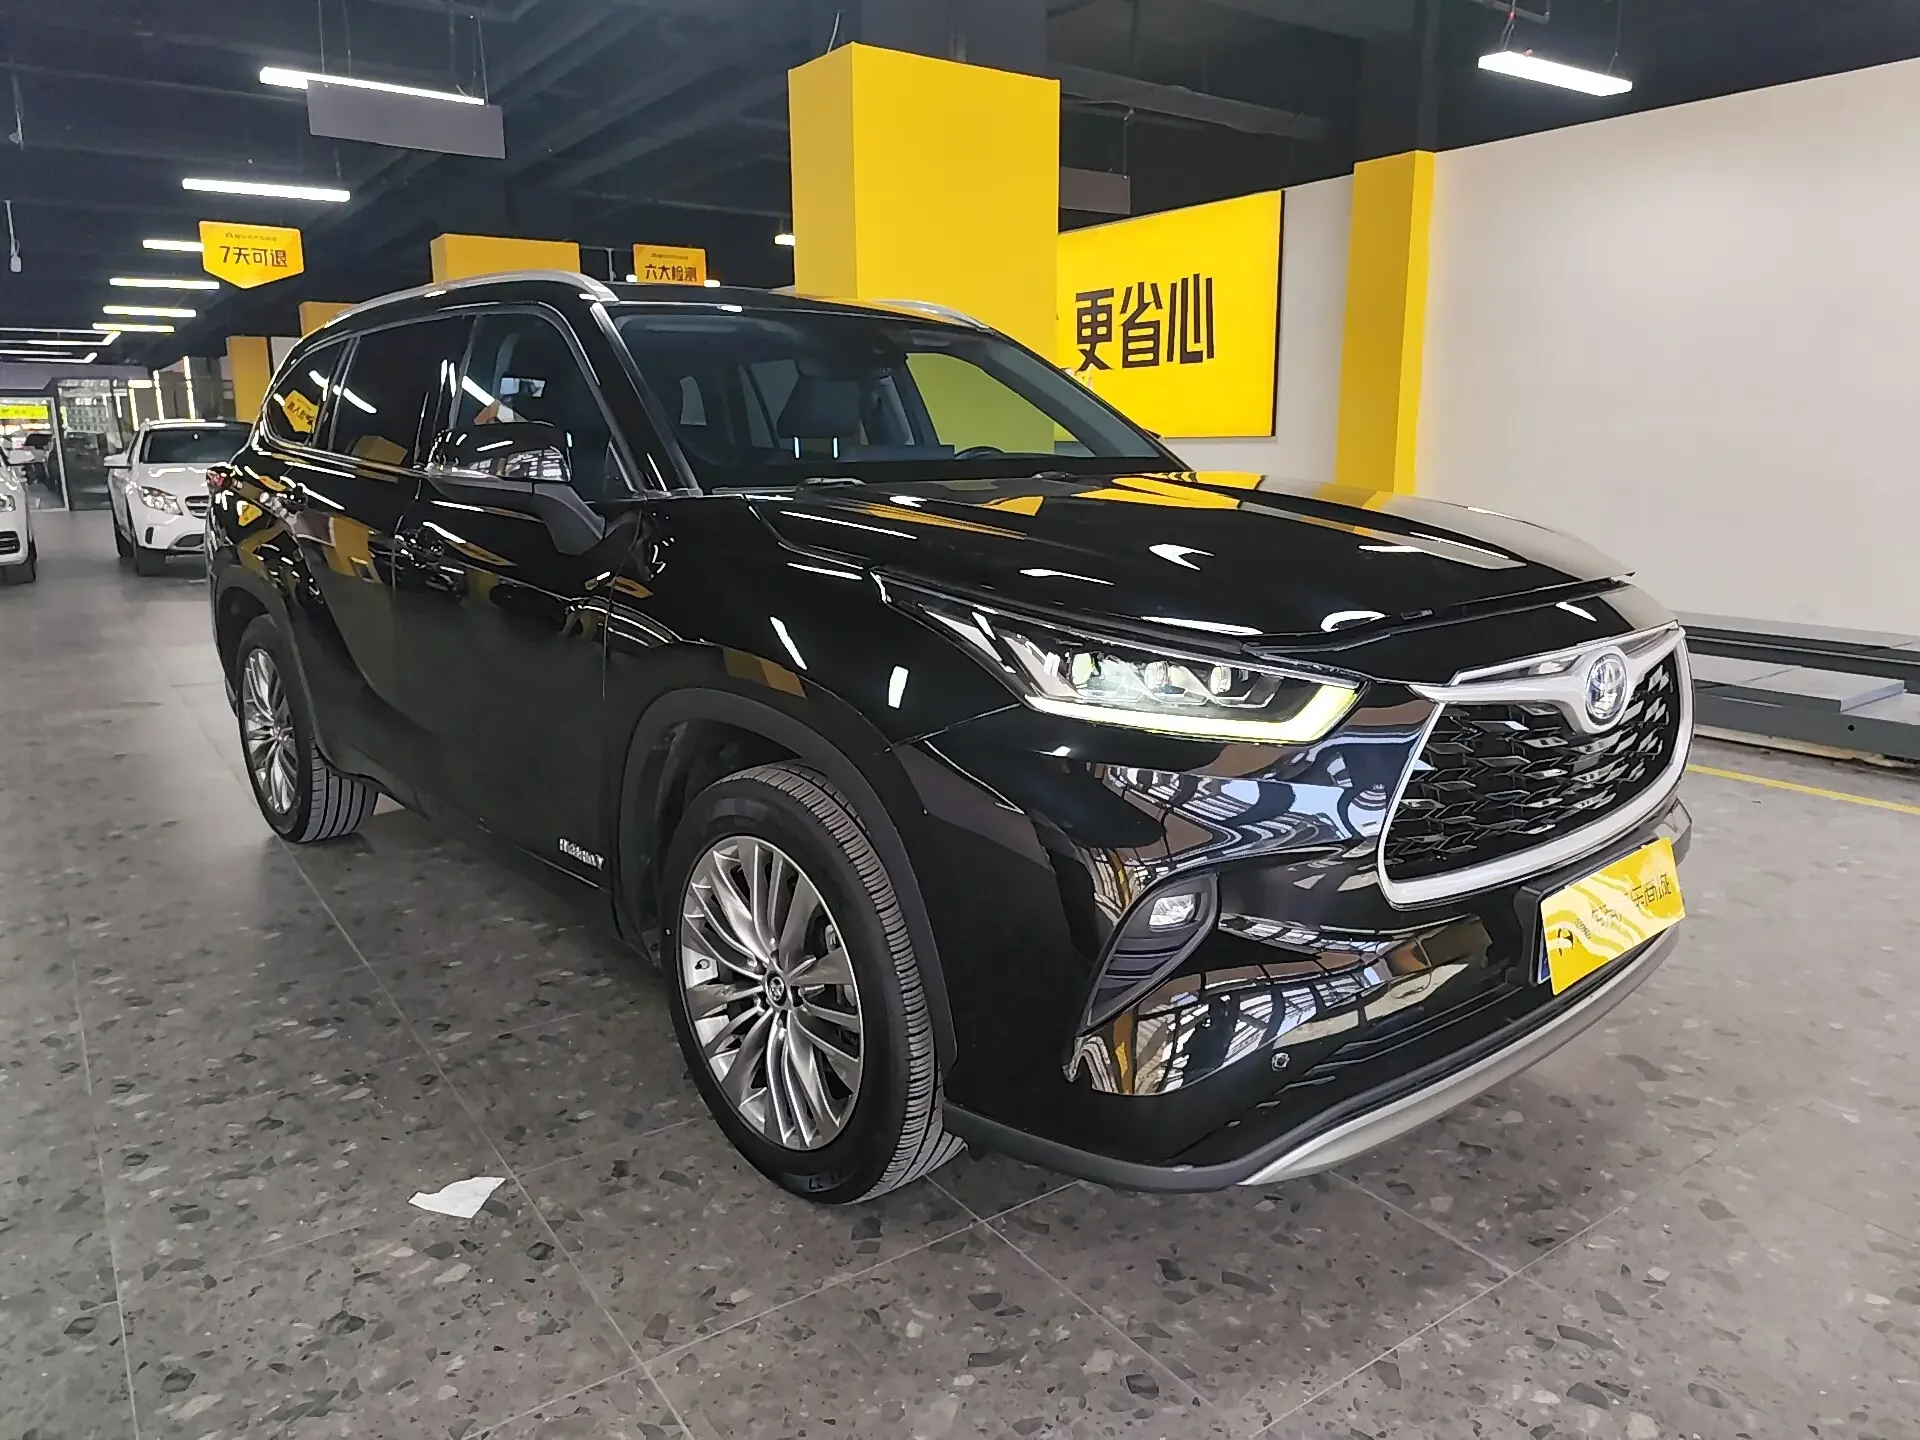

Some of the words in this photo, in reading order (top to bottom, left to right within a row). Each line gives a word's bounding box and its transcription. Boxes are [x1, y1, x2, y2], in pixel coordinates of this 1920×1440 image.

[219, 246, 288, 267] 7天可退
[1075, 273, 1215, 372] 更省心
